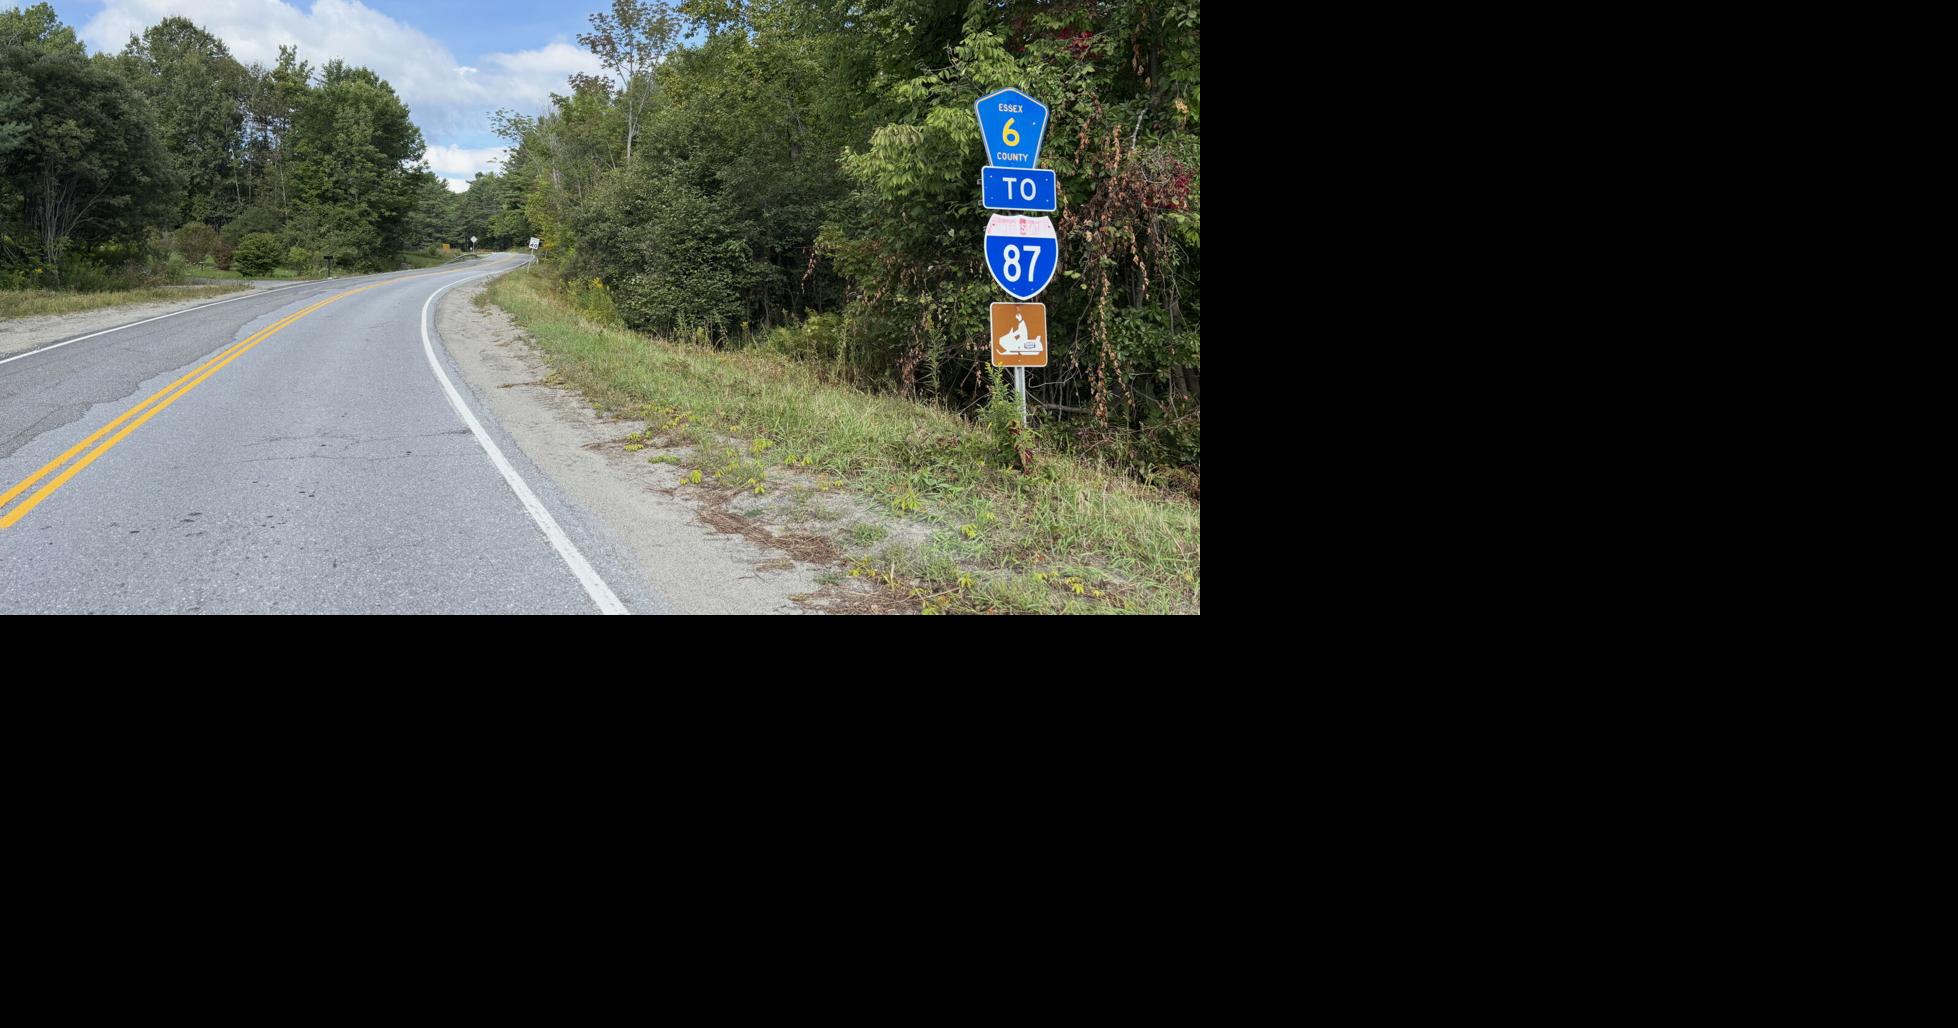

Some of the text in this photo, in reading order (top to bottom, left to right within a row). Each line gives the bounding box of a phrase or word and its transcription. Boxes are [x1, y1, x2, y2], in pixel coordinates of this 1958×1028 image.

[999, 104, 1023, 113] ESSEX
[1002, 117, 1020, 147] 6
[997, 152, 1028, 162] COUNTY
[1002, 177, 1036, 201] TO
[1003, 244, 1041, 282] 87
